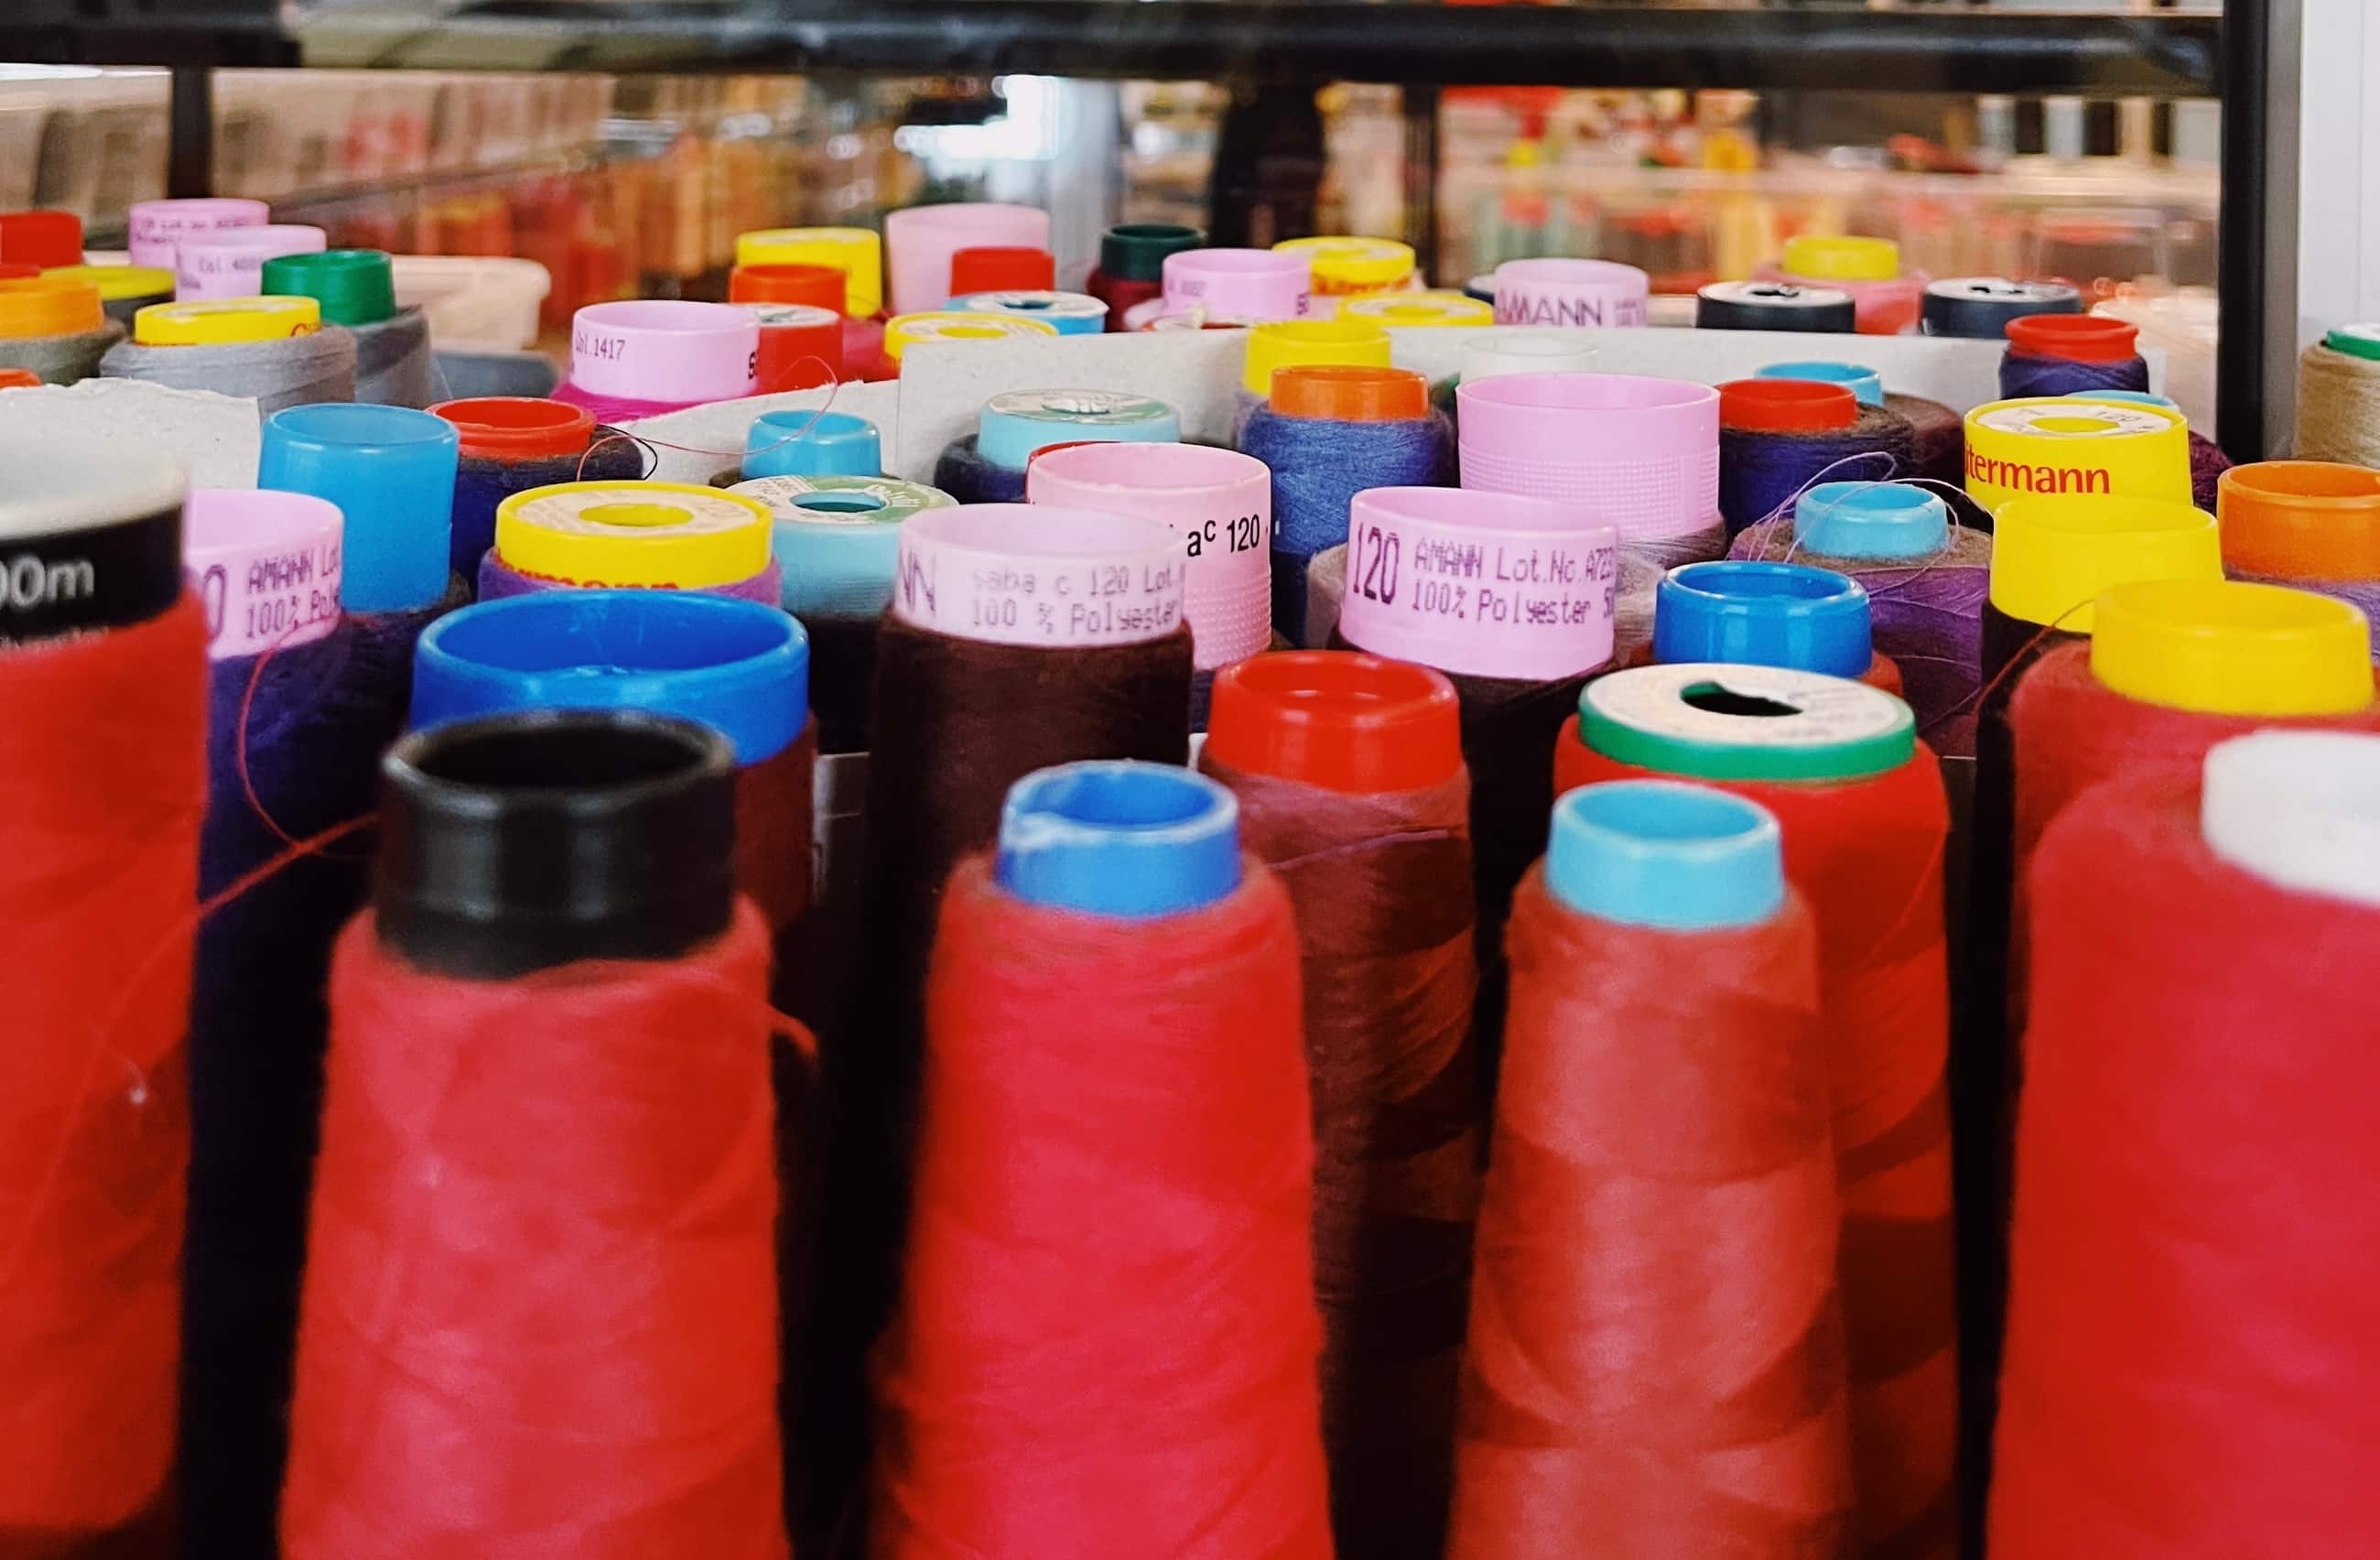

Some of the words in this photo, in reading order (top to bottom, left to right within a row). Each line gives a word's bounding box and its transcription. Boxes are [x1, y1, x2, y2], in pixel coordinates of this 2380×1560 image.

[1227, 514, 1260, 553] 120
[248, 549, 314, 593] AMANN
[1353, 522, 1401, 605] 120
[1414, 536, 1483, 579] AMANN
[0, 556, 95, 611] 0m
[1089, 565, 1130, 595] 120
[972, 598, 1017, 627] 100
[1069, 598, 1179, 634] Polyester
[1411, 580, 1466, 619] 100%
[1477, 589, 1591, 624] Polyester
